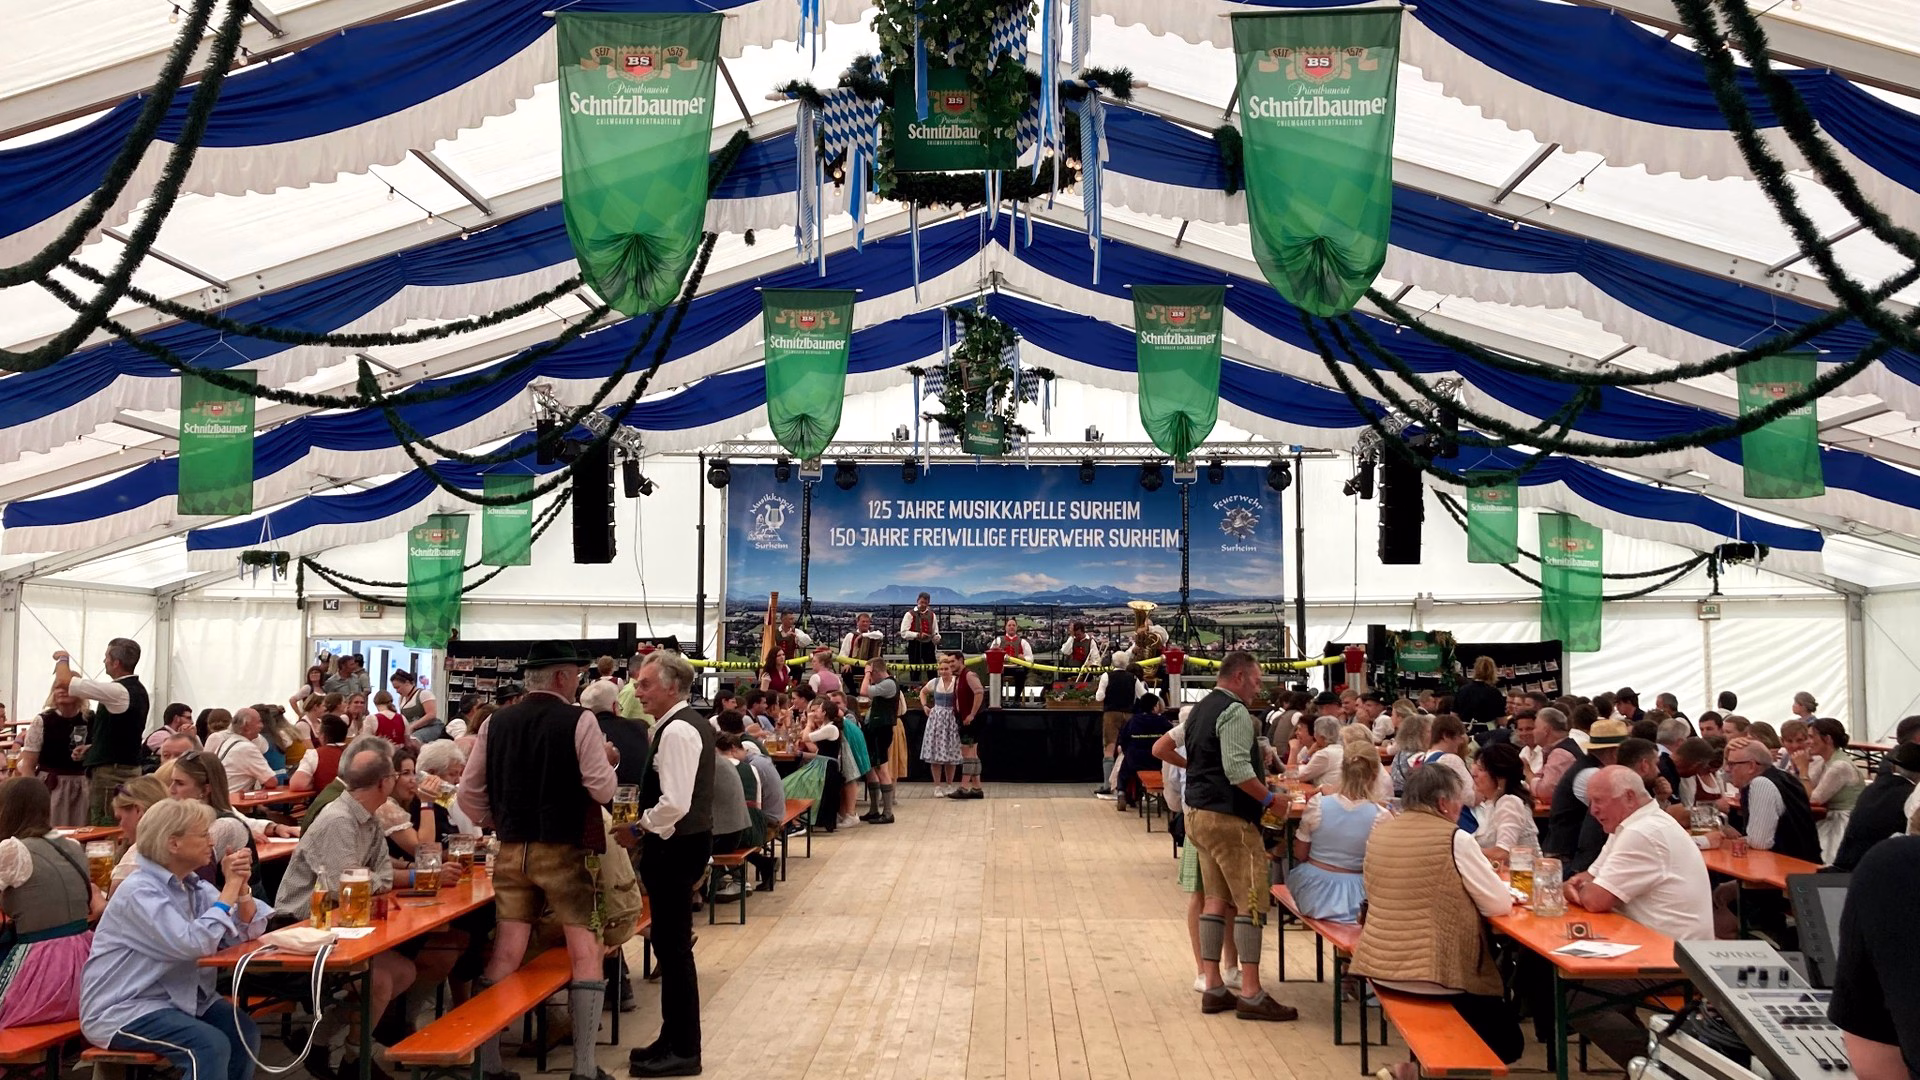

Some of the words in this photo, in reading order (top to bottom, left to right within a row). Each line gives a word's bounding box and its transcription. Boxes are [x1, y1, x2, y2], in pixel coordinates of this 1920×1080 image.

[595, 47, 609, 57] SEIT
[667, 47, 684, 57] 1575
[1272, 48, 1289, 58] SEIT
[1346, 47, 1363, 57] 1575
[627, 56, 650, 66] BS
[1307, 57, 1330, 67] BS
[608, 80, 669, 95] Privatbrauerei
[1288, 81, 1351, 96] Privatbrauerei
[569, 91, 706, 116] Schnitzlbaumer
[1249, 95, 1387, 119] Schnitzlbaumer
[1276, 119, 1316, 127] CHIEMGAUER
[770, 336, 846, 350] Schnitzlbaumer
[1141, 331, 1216, 344] Schnitzlbaumer
[184, 422, 248, 434] Schnitzlbaumer
[750, 492, 795, 514] Musikkapelle
[1212, 494, 1264, 510] Feuerwehr
[868, 500, 892, 519] 125
[897, 500, 945, 519] JAHRE
[950, 500, 1066, 520] MUSIKKAPELLE
[1070, 501, 1140, 520] SURHEIM
[829, 528, 856, 546] 150
[860, 528, 909, 546] JAHRE
[914, 528, 1007, 546] FREIWILLIGE
[1011, 528, 1104, 547] FEUERWEHR
[1108, 528, 1179, 548] SURHEIM
[755, 541, 788, 550] Surheim
[1221, 544, 1257, 552] Surheim
[325, 600, 338, 609] WC
[1263, 661, 1296, 672] AHRE
[1708, 951, 1769, 960] WING
